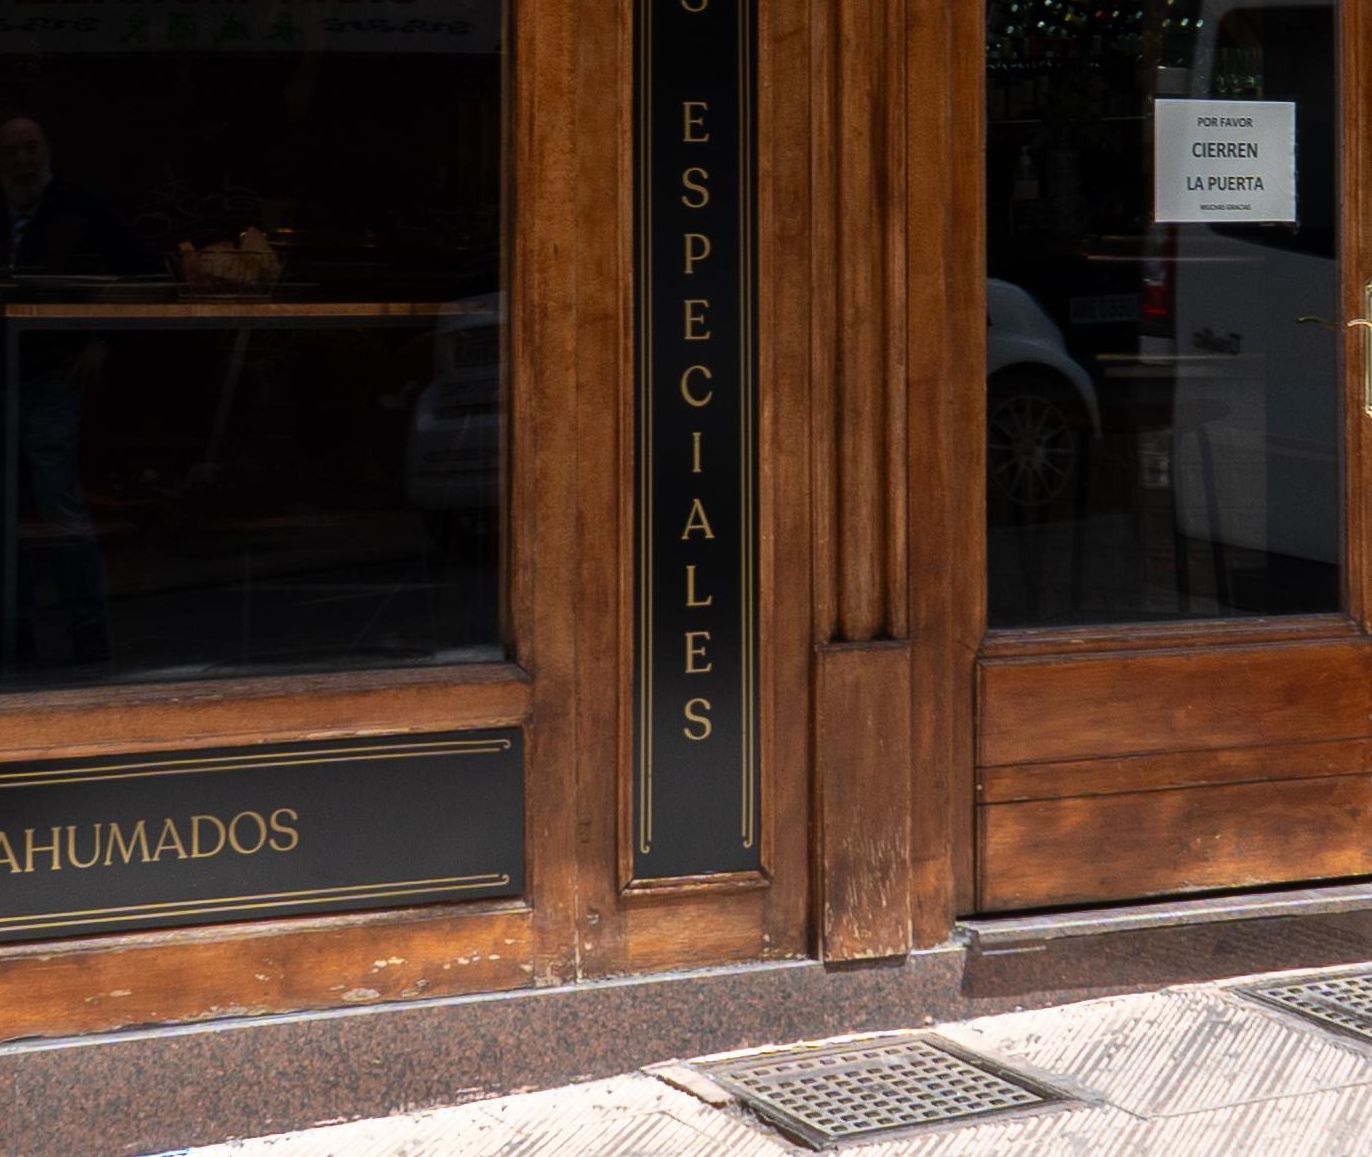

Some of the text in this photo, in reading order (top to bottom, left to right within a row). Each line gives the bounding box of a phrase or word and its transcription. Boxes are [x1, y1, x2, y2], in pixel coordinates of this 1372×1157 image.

[1197, 117, 1253, 128] POR FAVOR
[1192, 142, 1258, 158] CIERREN
[1187, 176, 1264, 191] LA PUERTA
[680, 101, 716, 741] ESPECIALES
